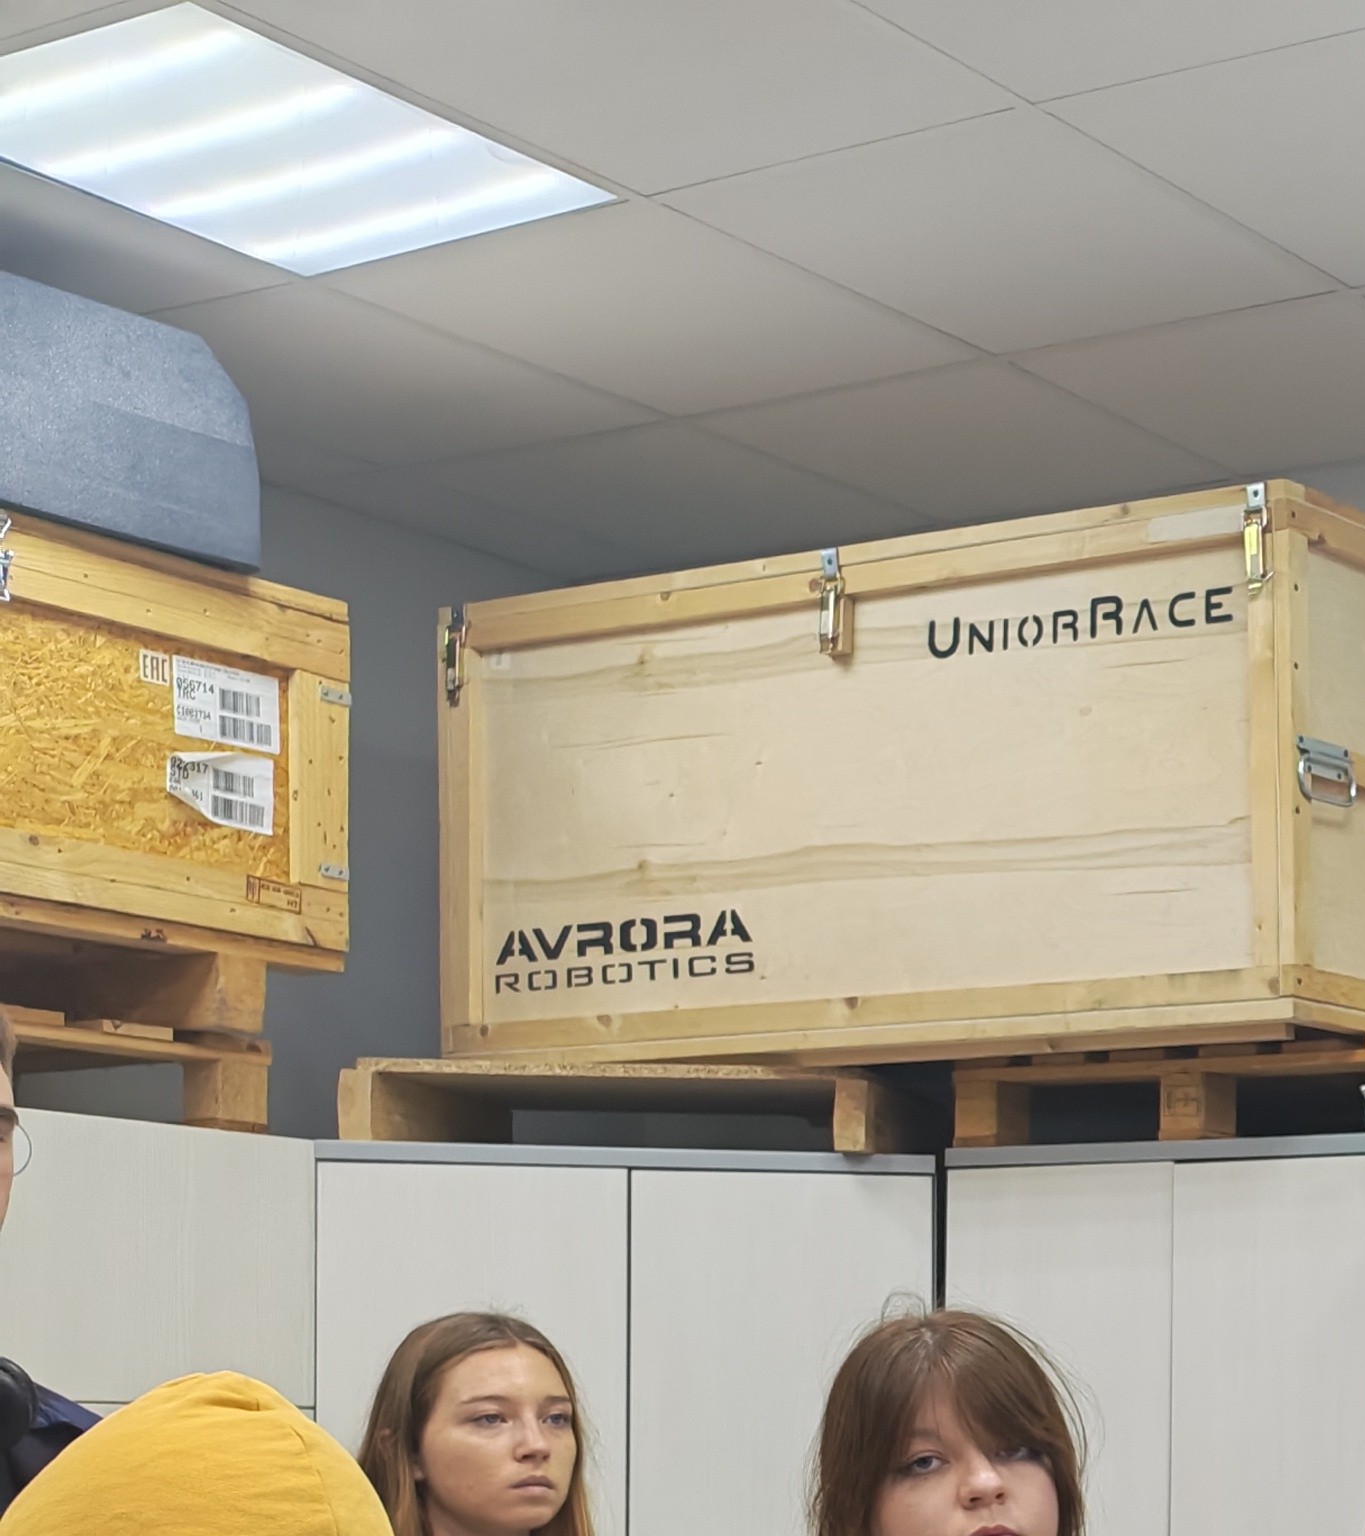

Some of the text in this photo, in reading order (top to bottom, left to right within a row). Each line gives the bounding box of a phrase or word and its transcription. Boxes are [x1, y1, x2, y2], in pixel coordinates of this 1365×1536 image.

[142, 654, 168, 683] EAC
[495, 909, 754, 966] AVRORA
[494, 952, 755, 994] ROBOTICS
